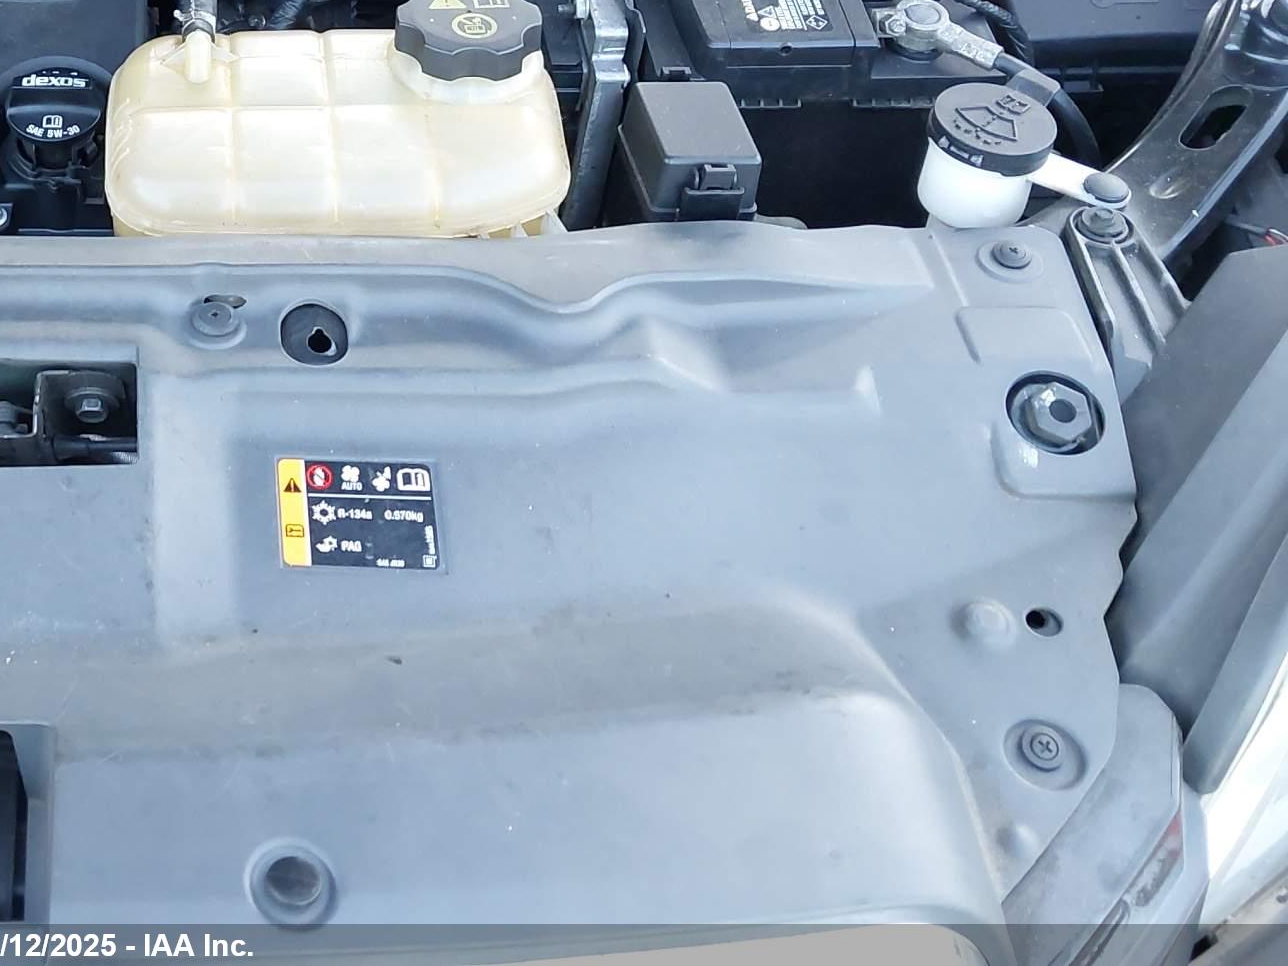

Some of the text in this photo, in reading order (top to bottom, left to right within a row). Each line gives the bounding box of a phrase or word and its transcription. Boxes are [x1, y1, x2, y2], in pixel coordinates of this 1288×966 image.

[21, 74, 89, 87] dexos
[25, 124, 81, 139] SAE 5W-30
